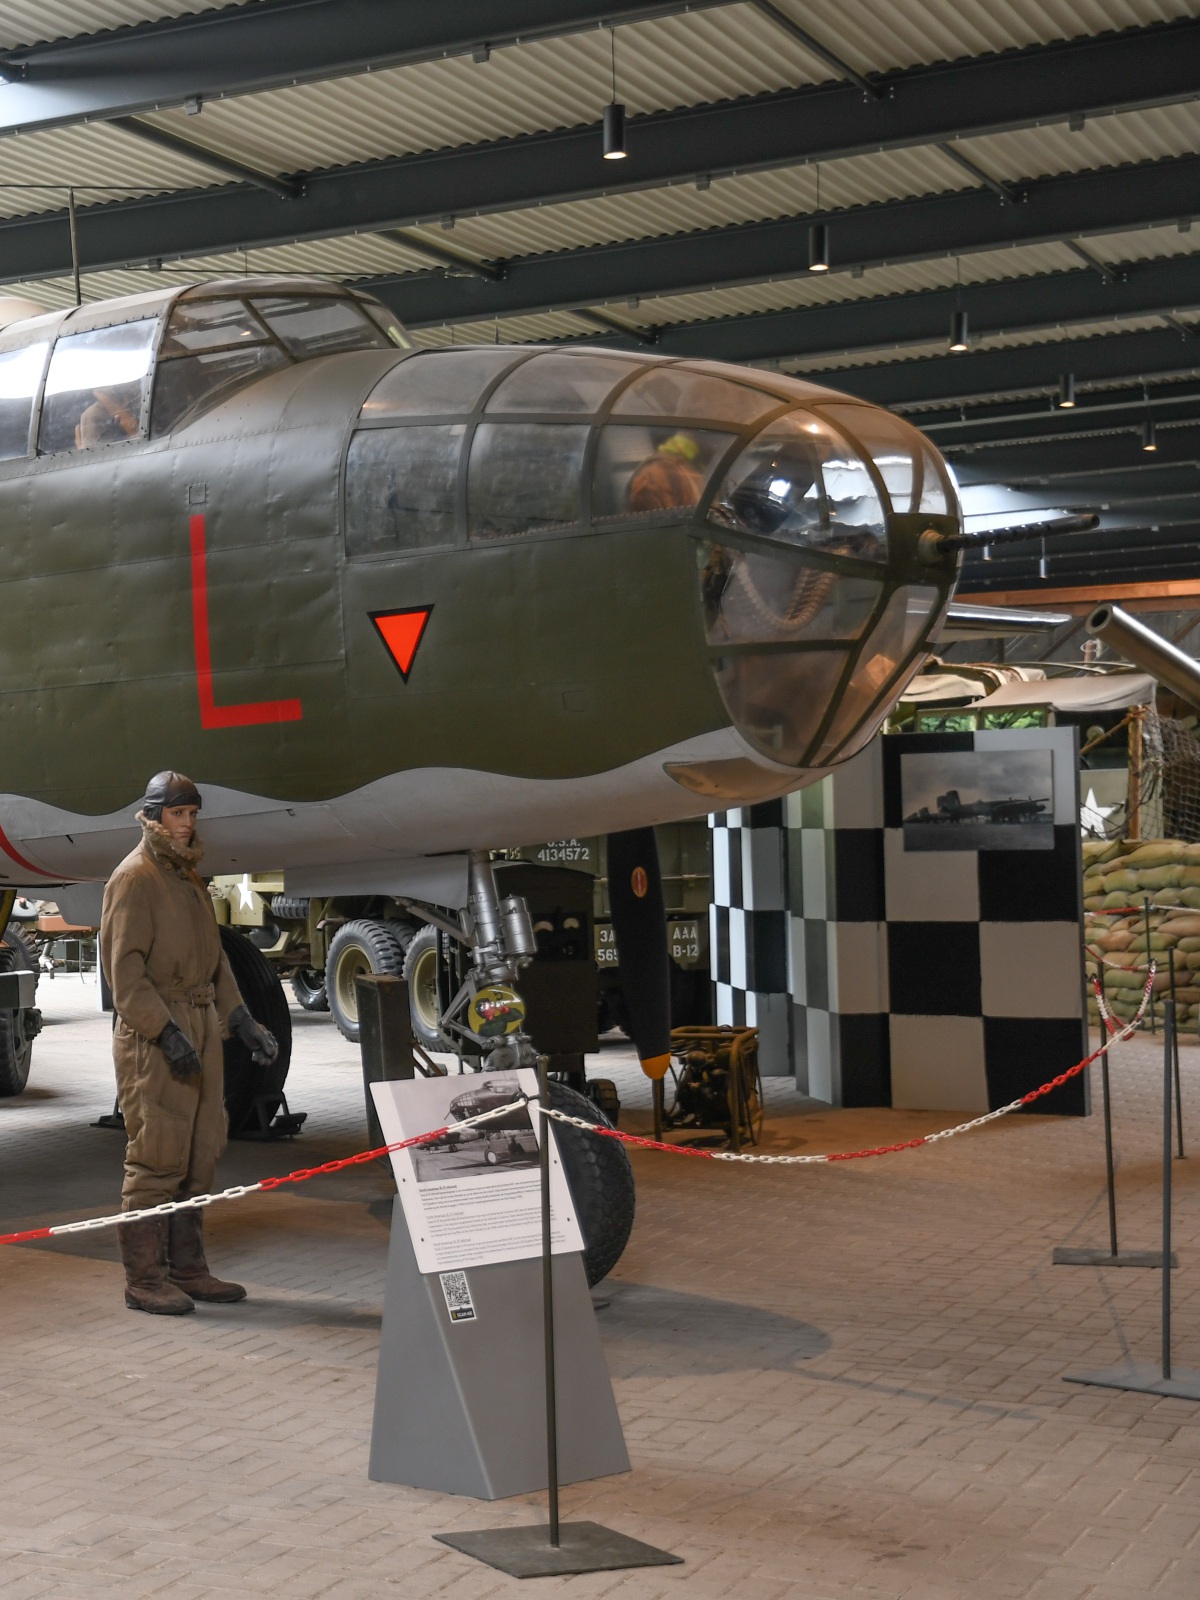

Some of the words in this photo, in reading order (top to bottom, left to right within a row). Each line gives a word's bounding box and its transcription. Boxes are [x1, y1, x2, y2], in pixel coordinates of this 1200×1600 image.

[190, 514, 302, 729] L
[537, 847, 590, 861] 4134572
[673, 926, 697, 940] AAA
[673, 944, 698, 957] B-12
